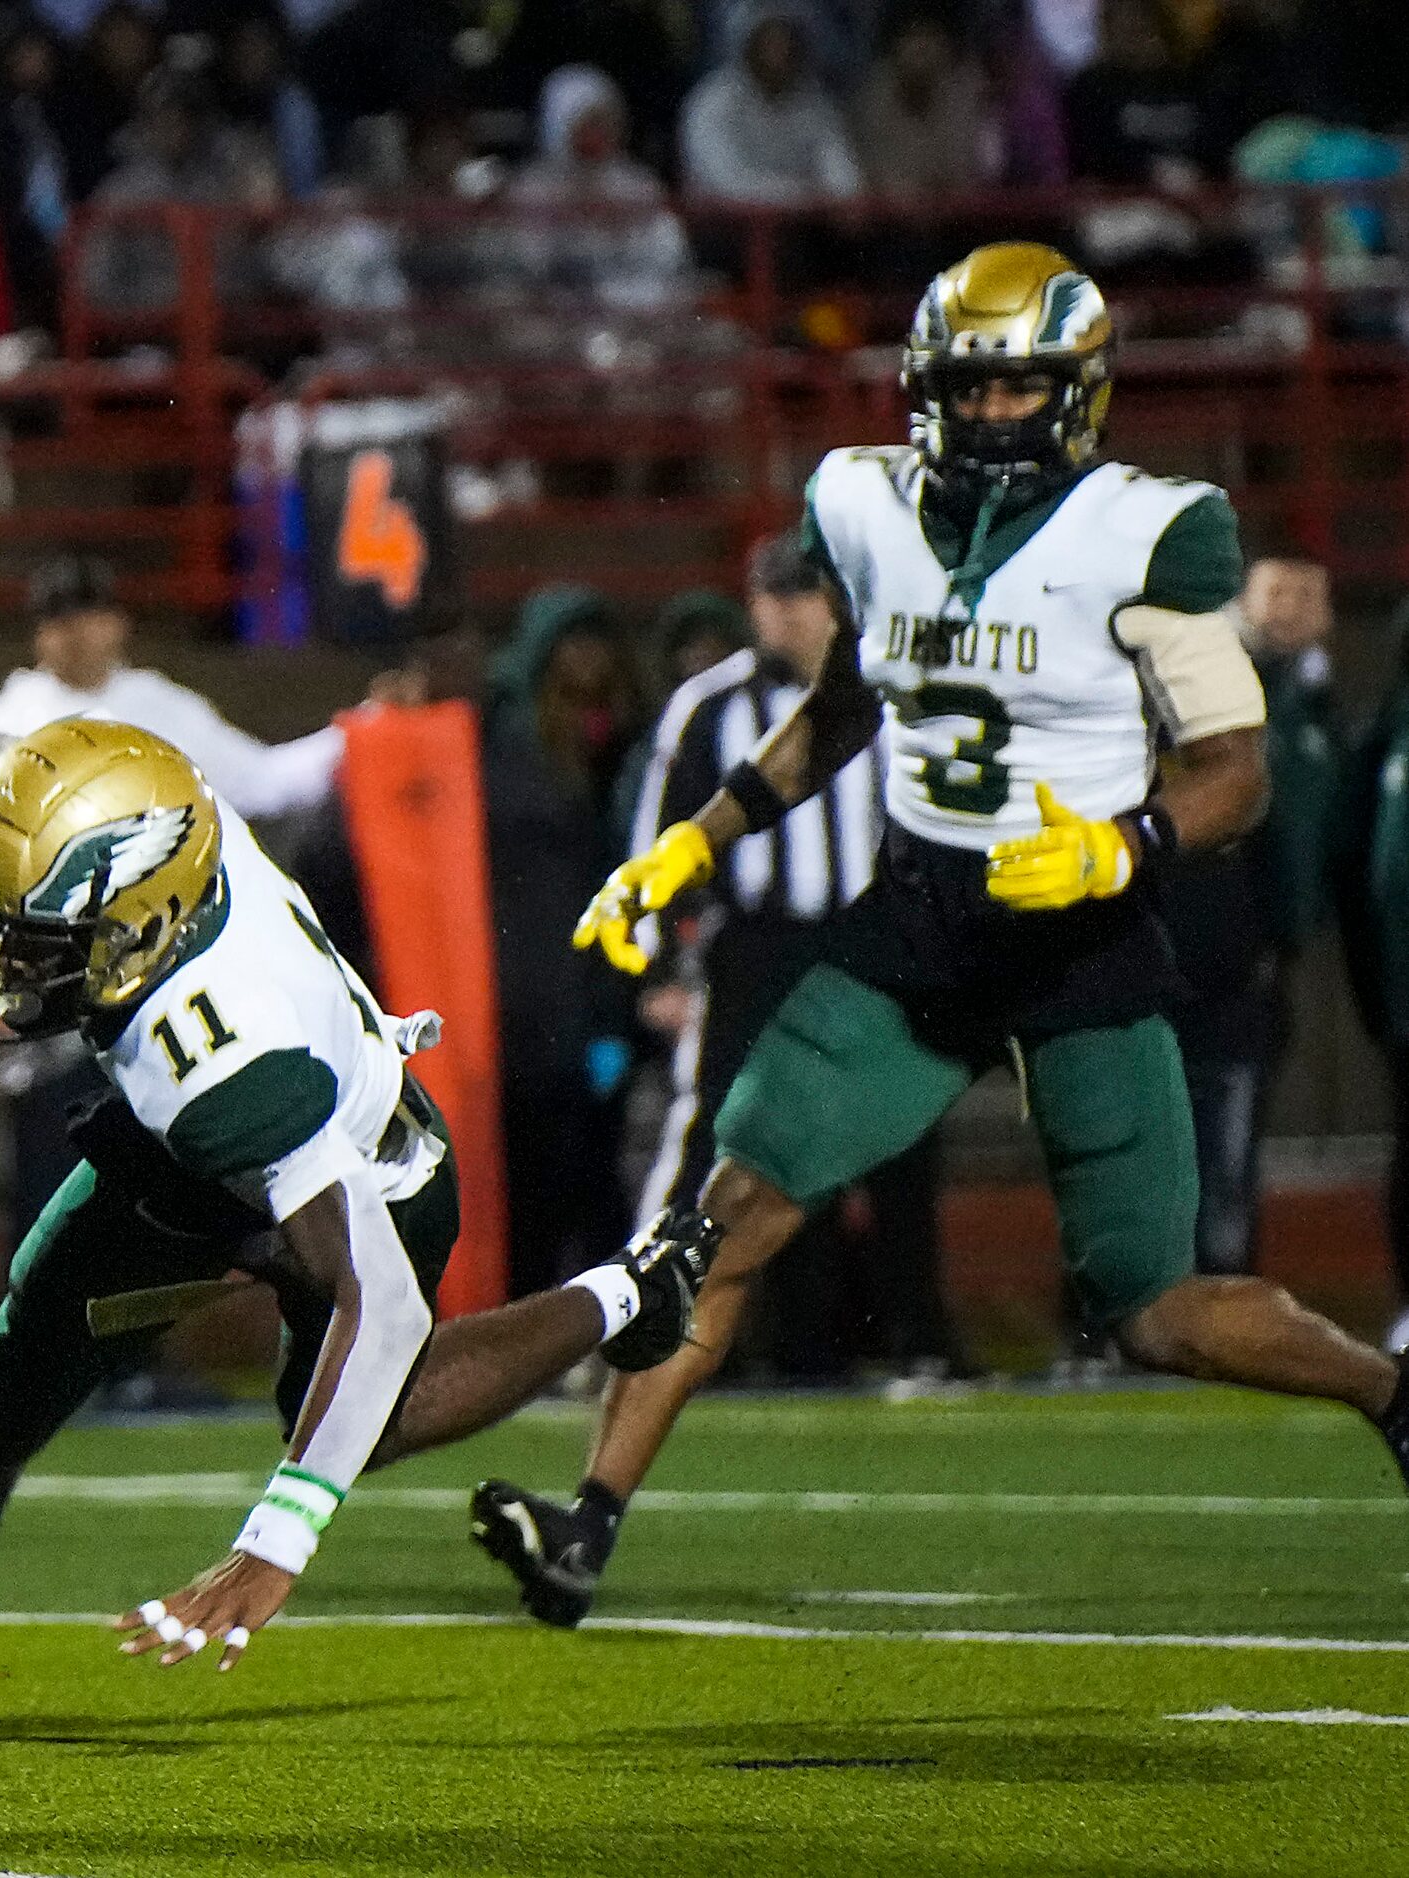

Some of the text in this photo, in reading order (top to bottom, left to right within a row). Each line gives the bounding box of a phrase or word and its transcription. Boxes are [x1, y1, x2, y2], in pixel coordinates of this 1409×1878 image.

[337, 450, 429, 608] 4
[896, 680, 1014, 817] 3
[150, 987, 240, 1087] 11
